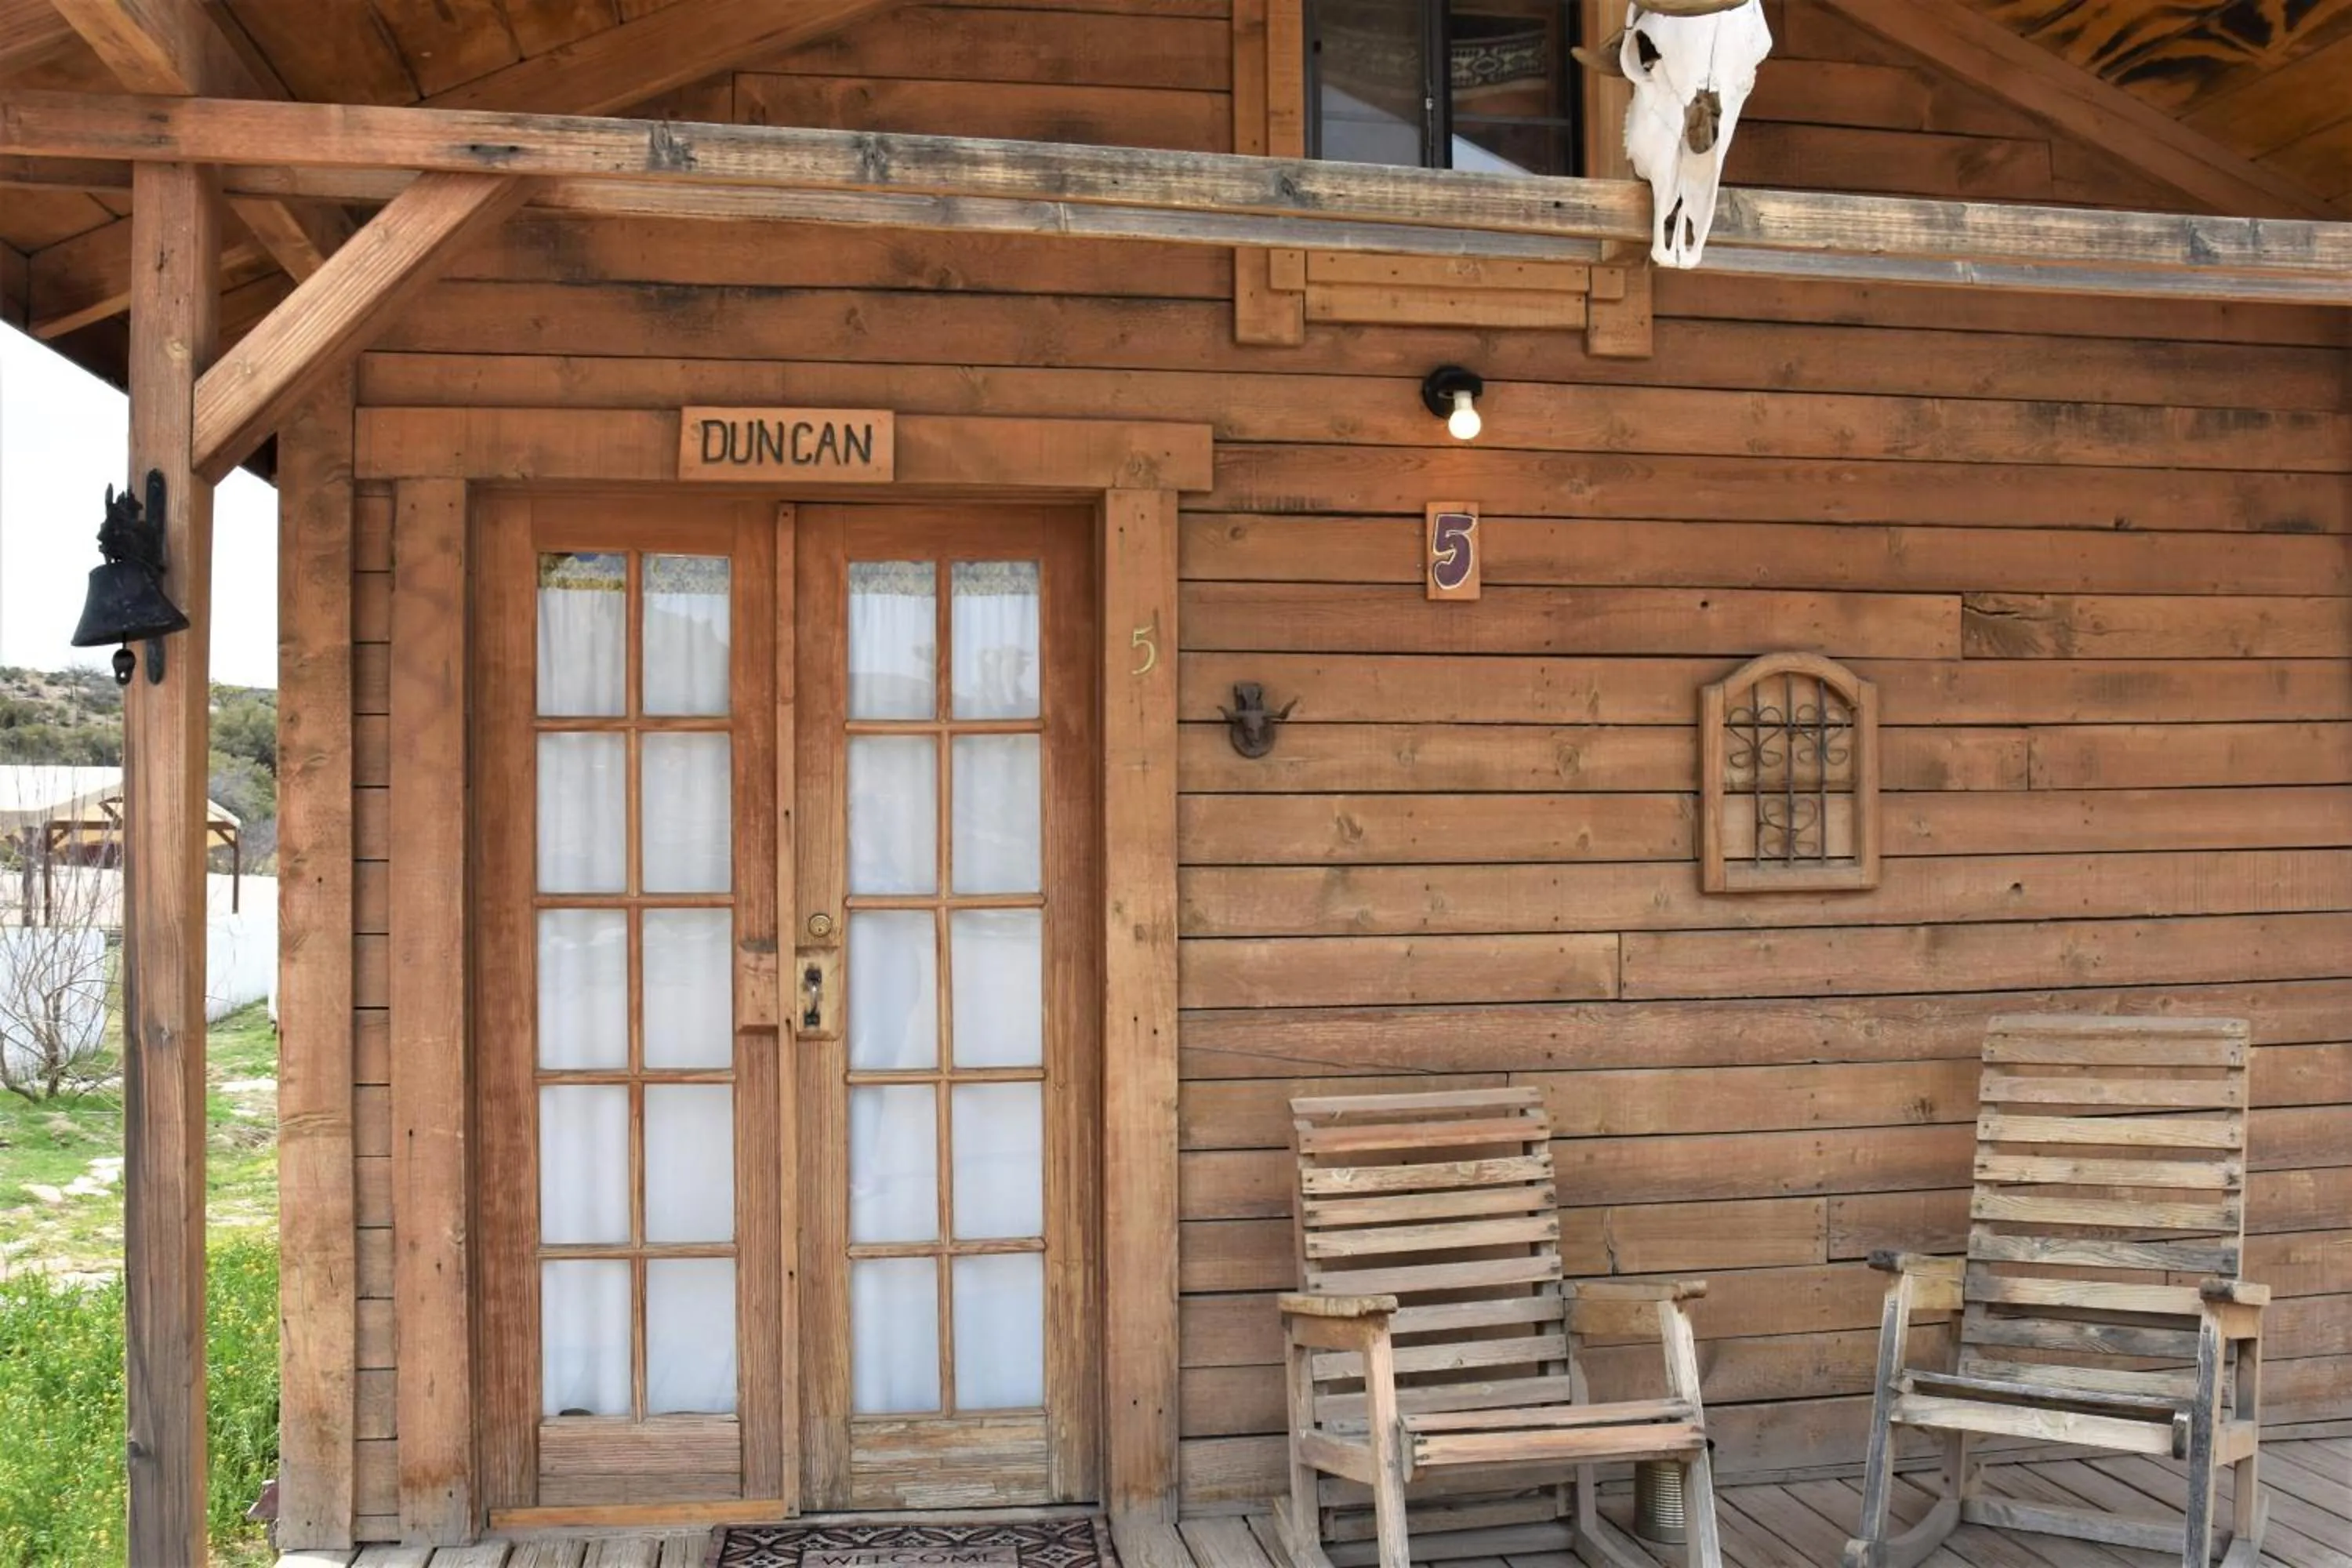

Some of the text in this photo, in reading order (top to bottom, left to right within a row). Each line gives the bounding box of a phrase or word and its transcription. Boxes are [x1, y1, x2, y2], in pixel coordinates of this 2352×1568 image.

[701, 419, 873, 465] DUNCAN
[1432, 513, 1476, 590] 5
[1131, 625, 1155, 675] 5
[822, 1553, 1000, 1565] WELCOME
